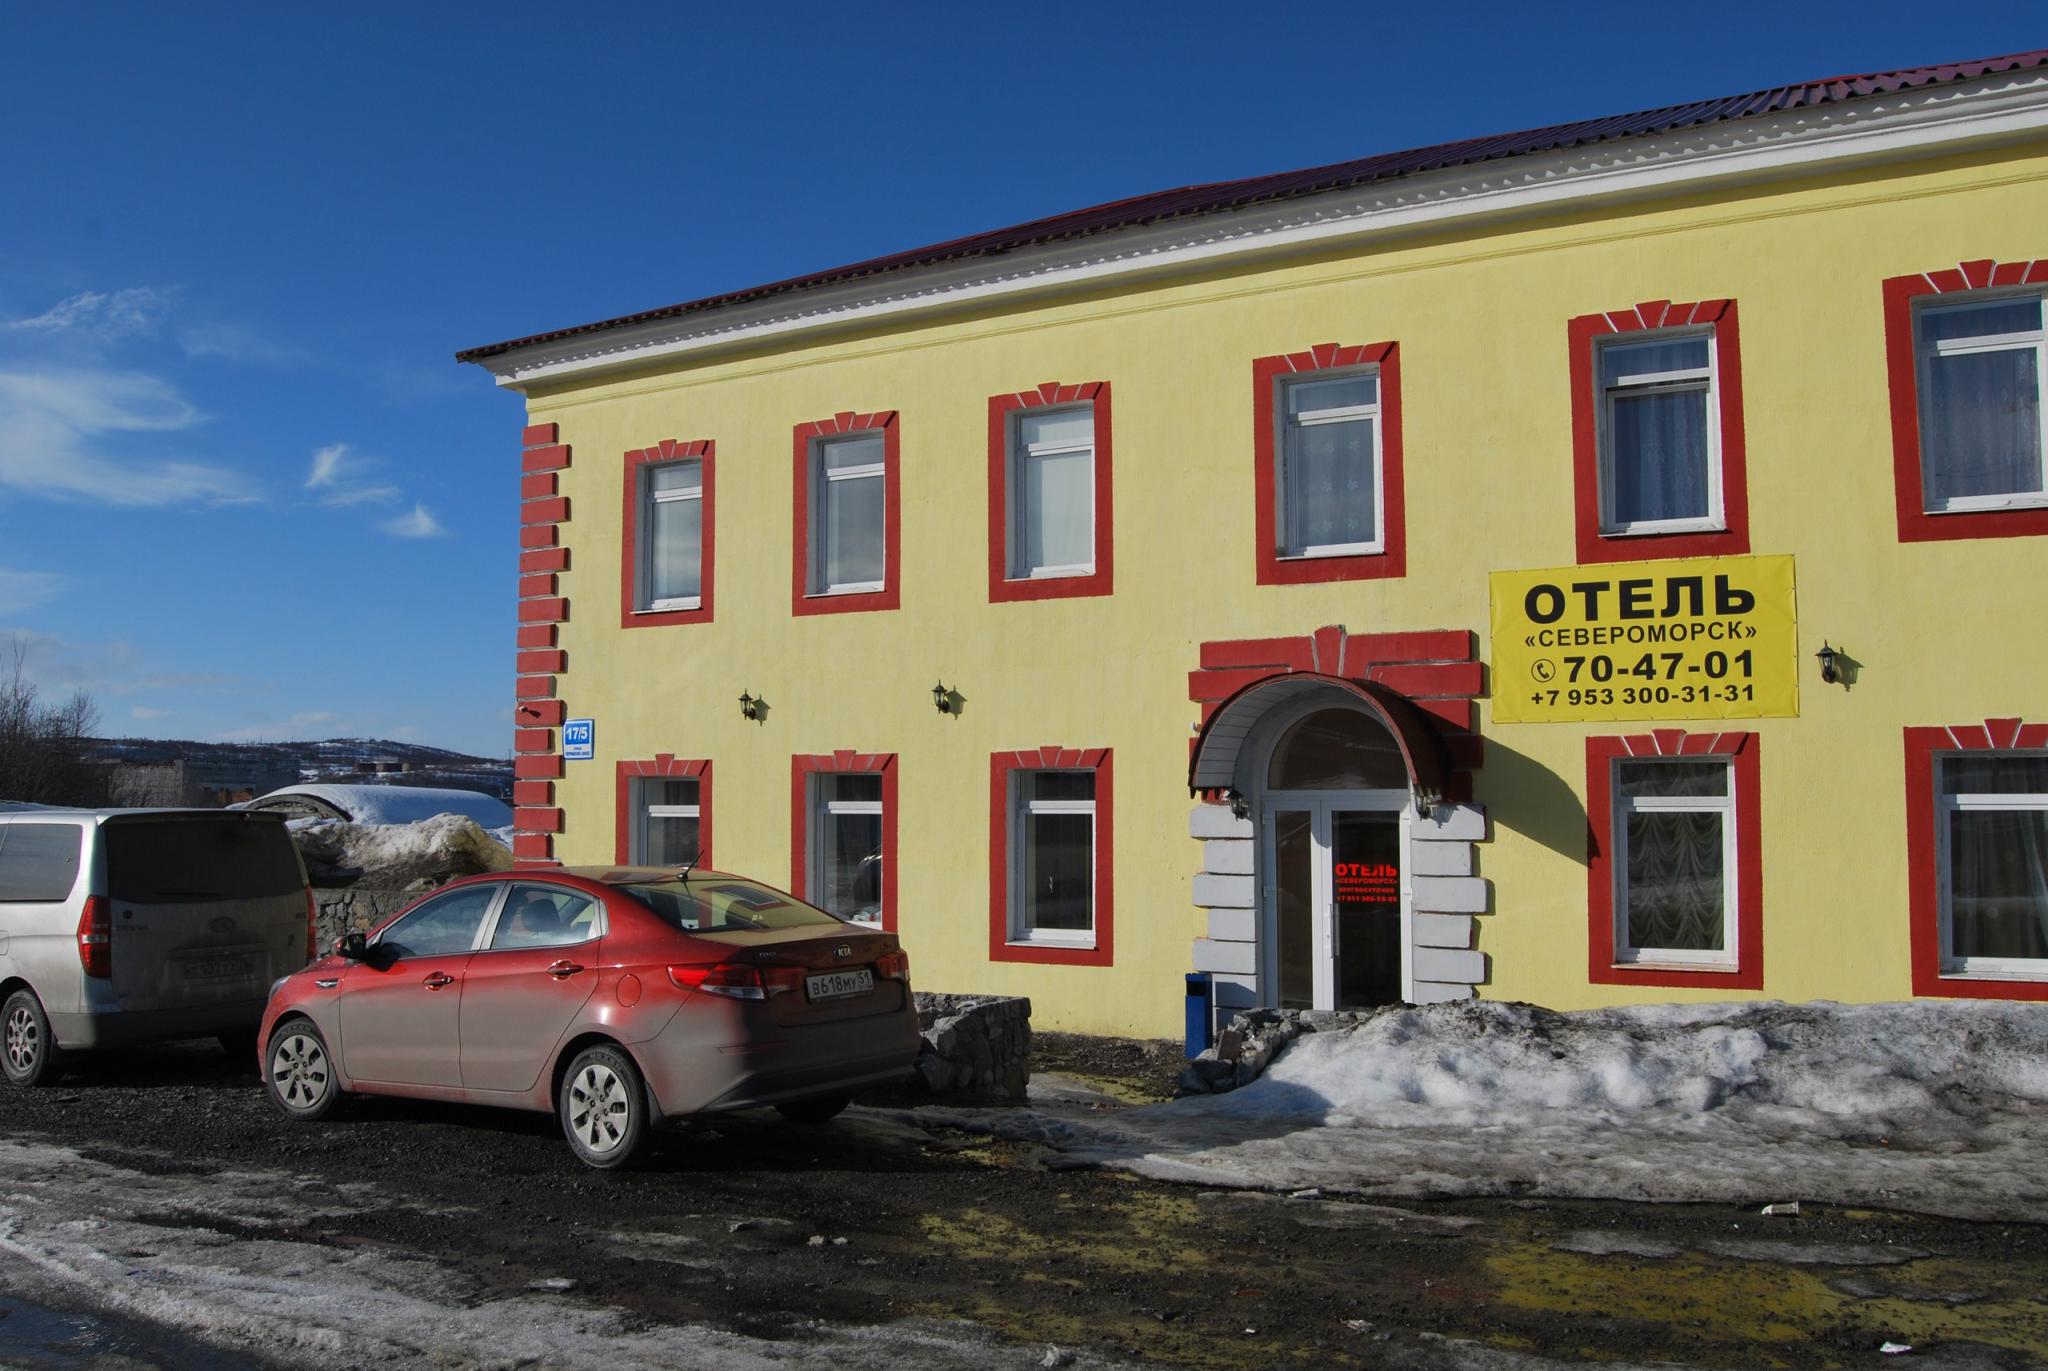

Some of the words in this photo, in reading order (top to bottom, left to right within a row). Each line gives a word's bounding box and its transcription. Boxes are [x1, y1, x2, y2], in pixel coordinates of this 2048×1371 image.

[1524, 574, 1756, 625] ОТЕЛЬ
[1524, 621, 1757, 648] «СЕВЕРОМОРСК»
[1563, 650, 1753, 683] 70-47-01
[1531, 690, 1560, 706] +7
[1568, 688, 1614, 706] 953
[1622, 684, 1754, 705] 300-31-31
[566, 726, 588, 740] 17/5
[1335, 863, 1397, 877] ОТЕЛЬ
[838, 947, 852, 958] KIA
[858, 971, 870, 985] 51
